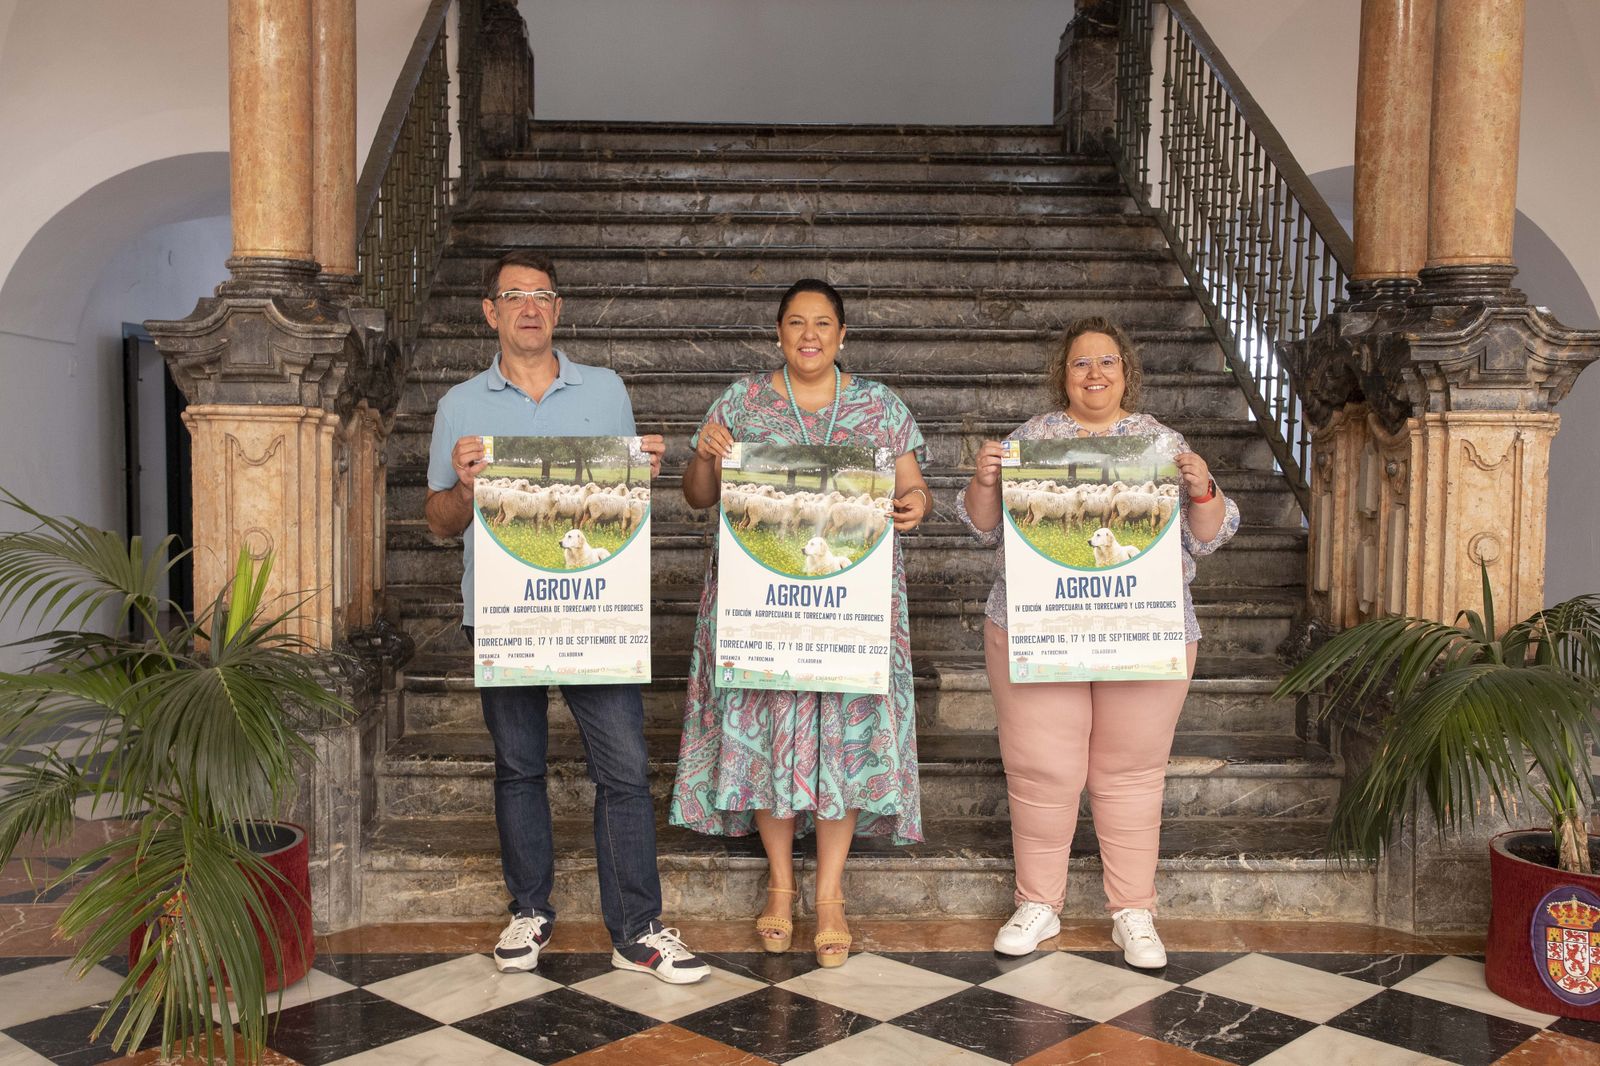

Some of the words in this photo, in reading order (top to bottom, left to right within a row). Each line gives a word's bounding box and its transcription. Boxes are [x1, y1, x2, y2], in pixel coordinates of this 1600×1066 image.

[524, 578, 606, 600] AGROVAP
[1056, 575, 1137, 599] AGROVAP
[766, 584, 847, 607] AGROVAP
[755, 610, 793, 618] AGROPECUARIA
[804, 612, 836, 620] TORRECAMPO
[478, 637, 522, 646] TORRECAMPO
[538, 637, 546, 645] 17
[556, 636, 563, 645] 18
[566, 637, 574, 645] DE
[577, 636, 616, 645] SEPTIEMBRE
[620, 635, 627, 644] DE
[630, 635, 648, 644] 2022
[1012, 635, 1055, 644] TORRECAMPO
[1071, 634, 1078, 642] 17
[1089, 634, 1096, 642] 18
[1099, 633, 1107, 642] DE
[1109, 632, 1150, 642] SEPTIEMBRE
[1153, 632, 1161, 641] DE
[1164, 632, 1183, 640] 2022
[720, 640, 762, 649] TORRECAMPO
[778, 642, 785, 650] 17
[796, 642, 803, 651] 18
[806, 643, 813, 651] DE
[816, 643, 856, 654] SEPTIEMBRE
[858, 645, 867, 654] DE
[869, 646, 888, 654] 2022
